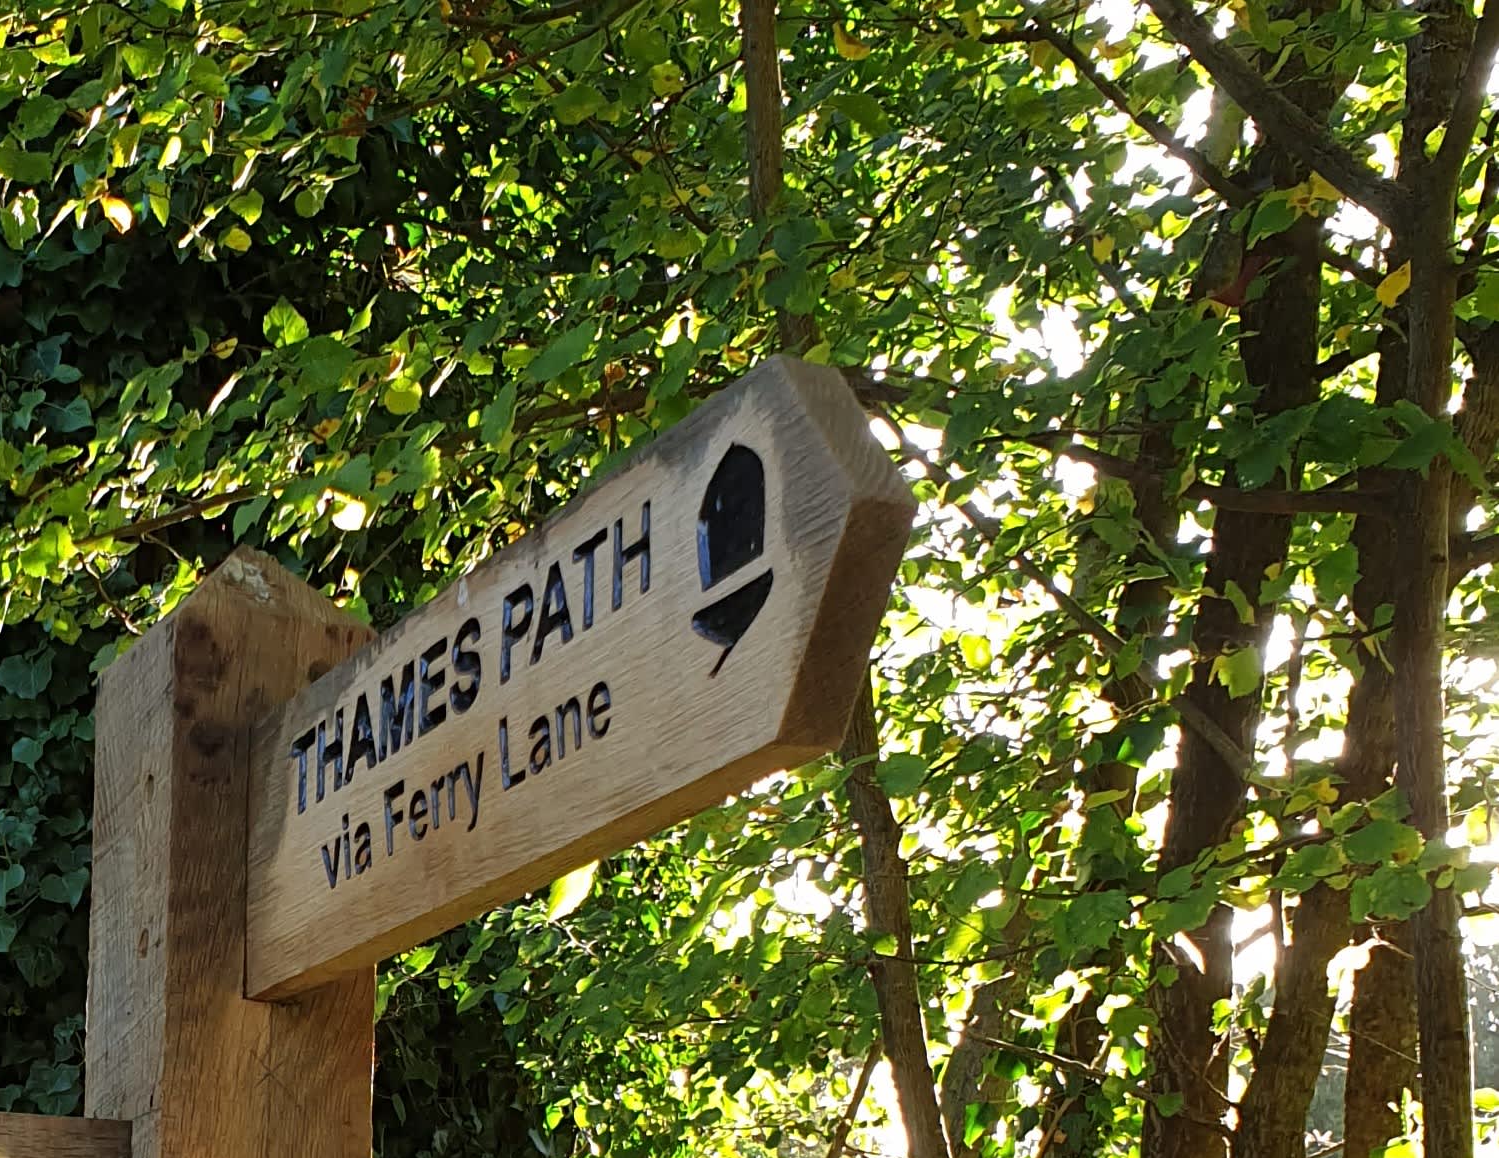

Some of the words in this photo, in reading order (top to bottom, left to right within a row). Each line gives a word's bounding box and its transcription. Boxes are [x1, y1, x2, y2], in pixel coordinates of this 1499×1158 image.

[290, 616, 482, 816] THAMES
[499, 499, 651, 686] PATH
[320, 812, 373, 890] via
[382, 750, 486, 858] Ferry
[498, 680, 612, 792] Lane
